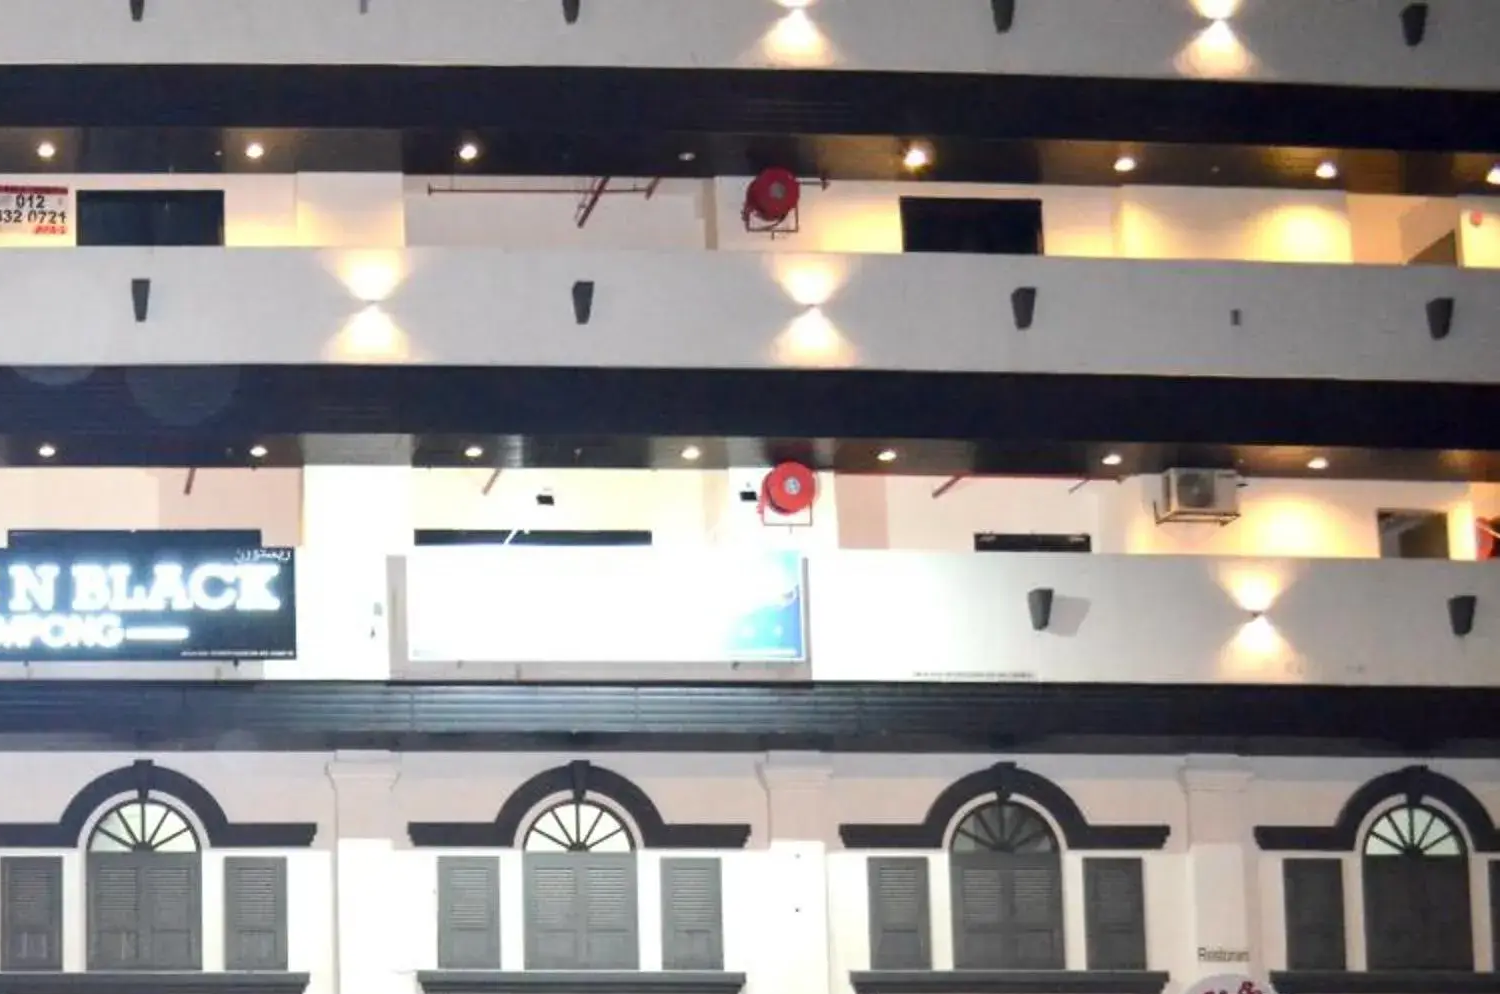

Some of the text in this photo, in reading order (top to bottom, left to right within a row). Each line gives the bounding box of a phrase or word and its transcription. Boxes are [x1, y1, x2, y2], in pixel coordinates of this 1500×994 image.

[16, 194, 45, 208] 012
[8, 563, 61, 612] N
[71, 563, 281, 611] BLACK
